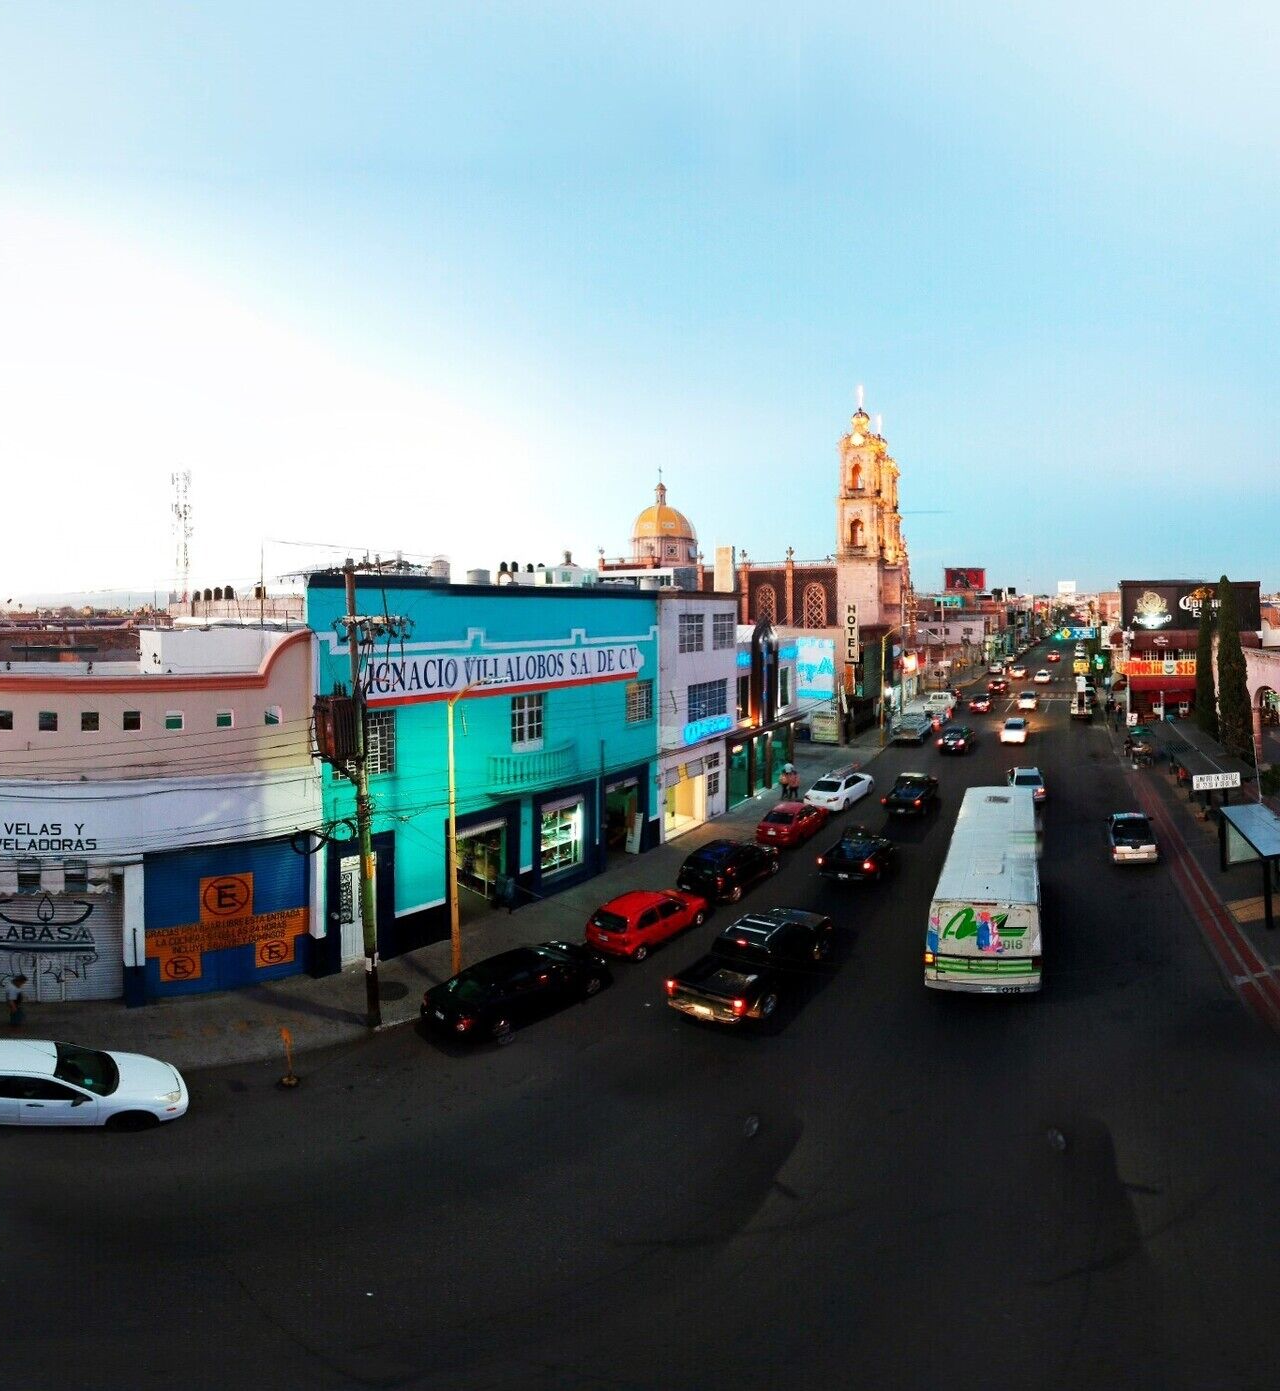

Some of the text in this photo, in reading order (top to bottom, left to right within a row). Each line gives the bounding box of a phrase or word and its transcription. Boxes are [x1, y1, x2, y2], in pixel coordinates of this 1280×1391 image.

[847, 604, 856, 659] HOTEL
[367, 658, 458, 694] IGNACIO
[463, 652, 565, 687] VILLALOBOS
[570, 652, 592, 676] S.A.
[597, 649, 615, 673] DE
[4, 822, 85, 836] VELAS Y
